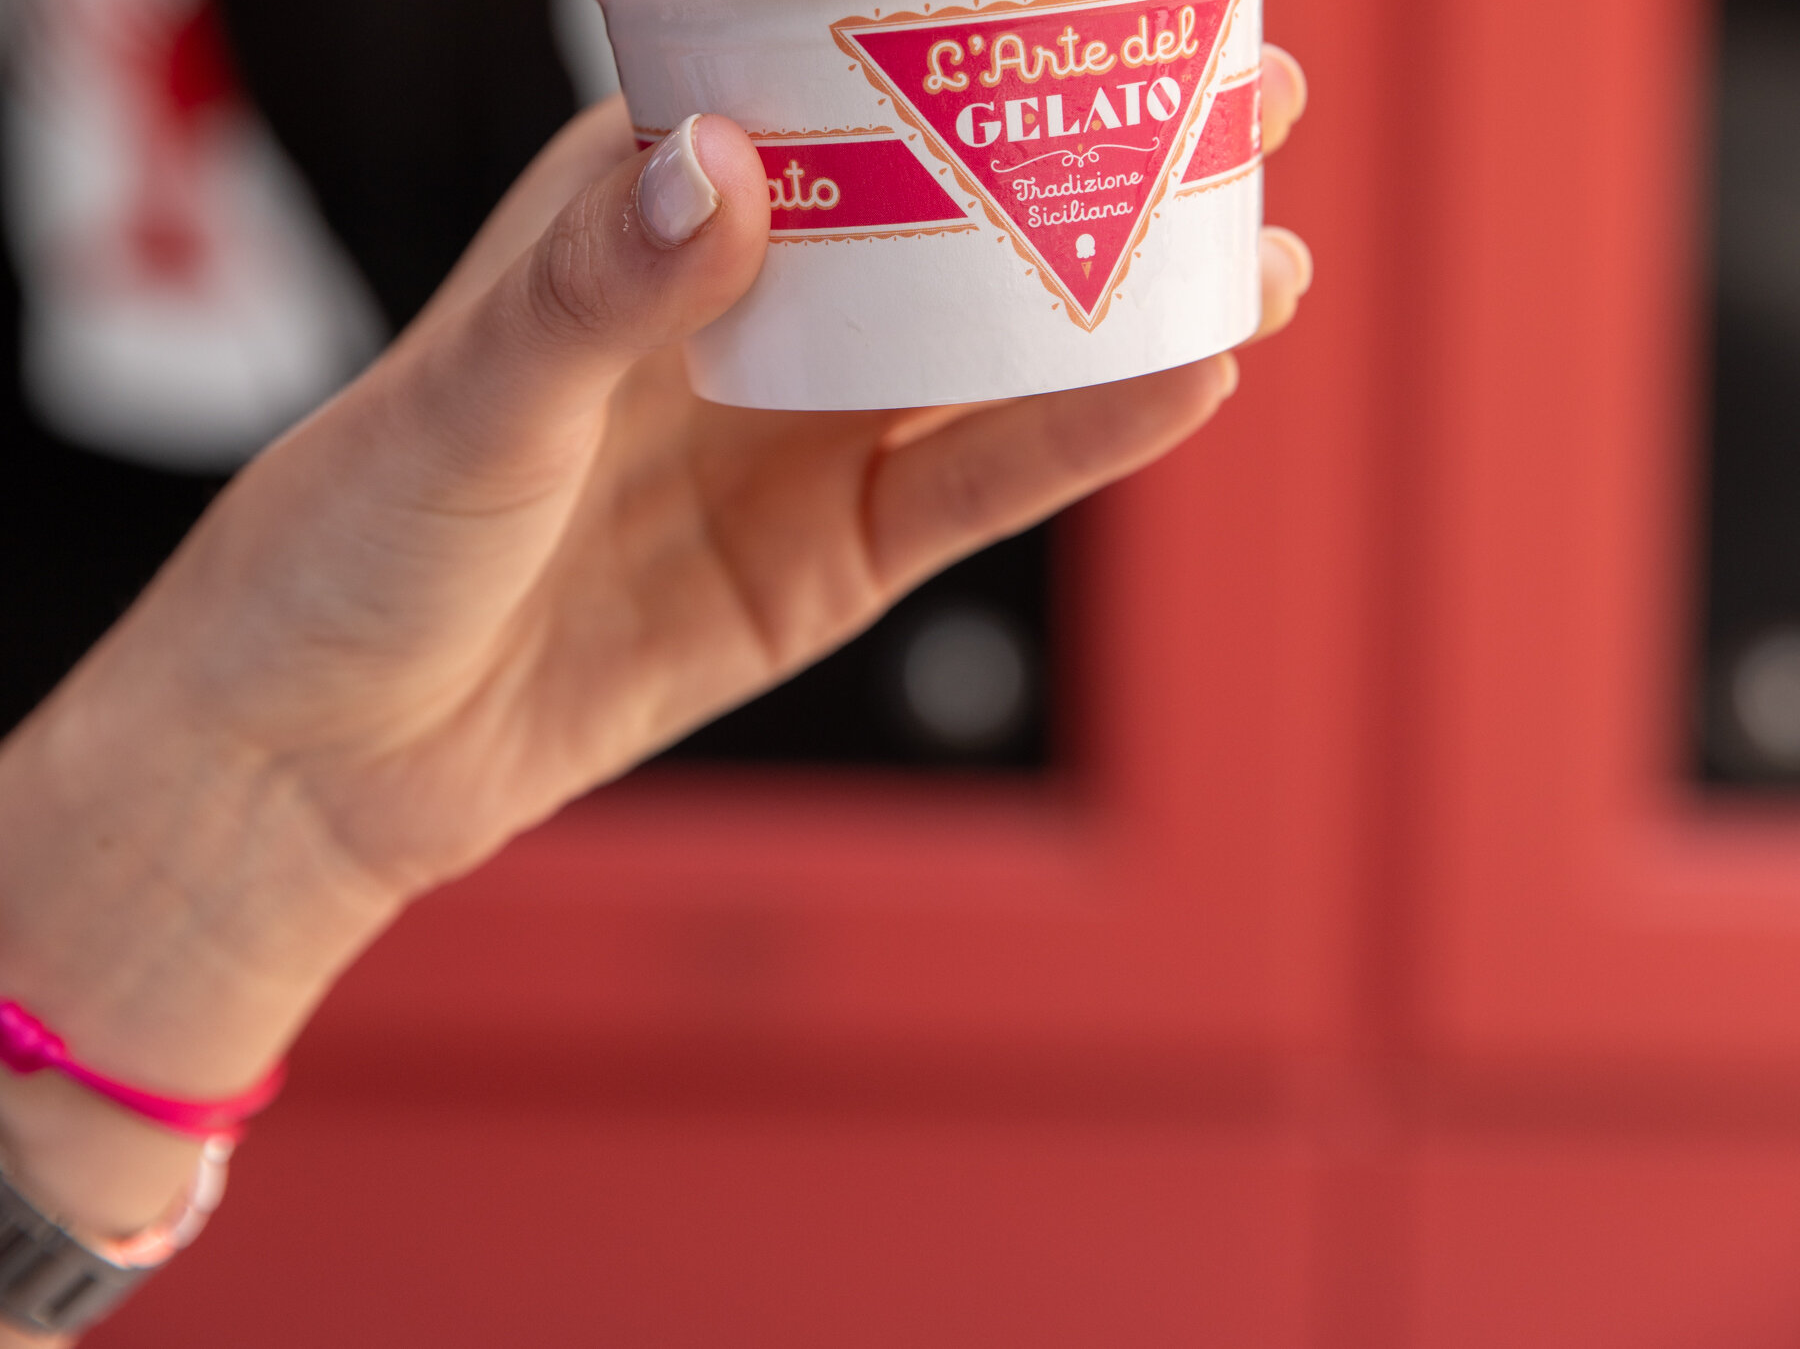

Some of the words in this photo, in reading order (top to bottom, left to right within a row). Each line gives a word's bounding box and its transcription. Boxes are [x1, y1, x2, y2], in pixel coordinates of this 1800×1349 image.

[924, 26, 1118, 94] L'Arte
[1121, 5, 1200, 70] del
[955, 75, 1182, 148] GELATO
[1012, 171, 1144, 202] Tradizione
[1028, 199, 1134, 228] Siciliana
